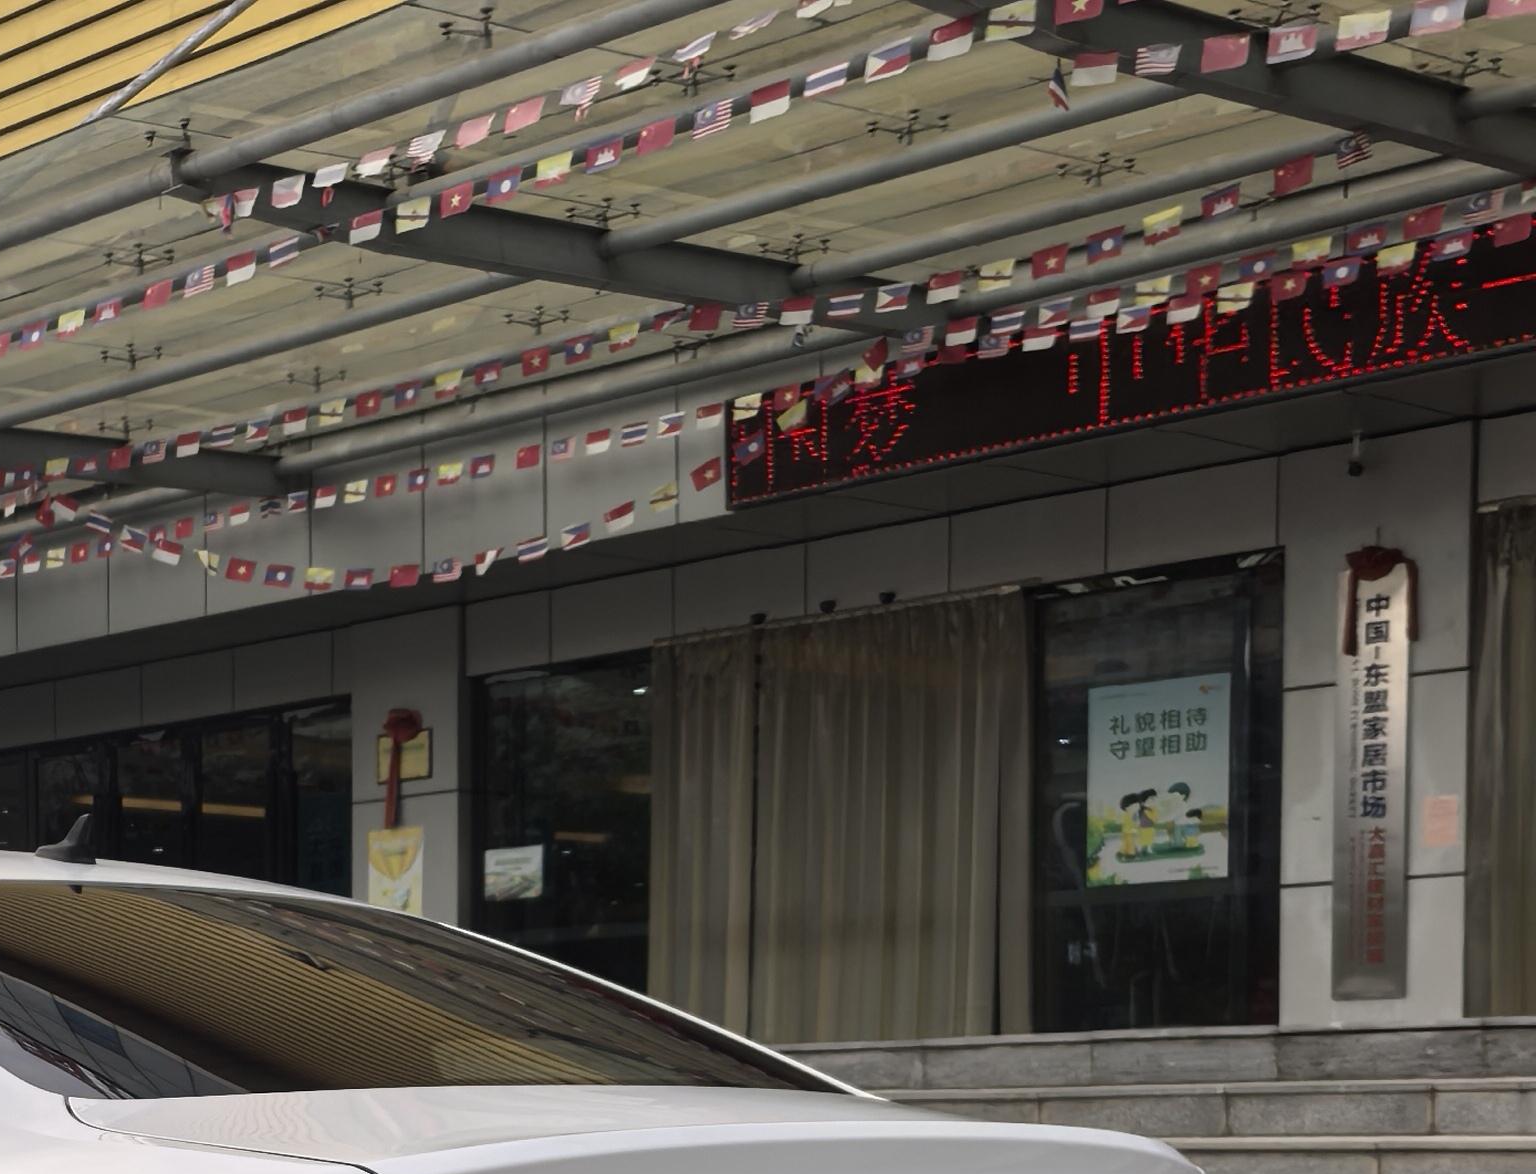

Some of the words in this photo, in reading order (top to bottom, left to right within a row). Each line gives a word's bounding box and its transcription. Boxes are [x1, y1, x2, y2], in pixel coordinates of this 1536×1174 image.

[1109, 707, 1207, 735] 礼貌相待
[1110, 731, 1207, 760] 守望相助
